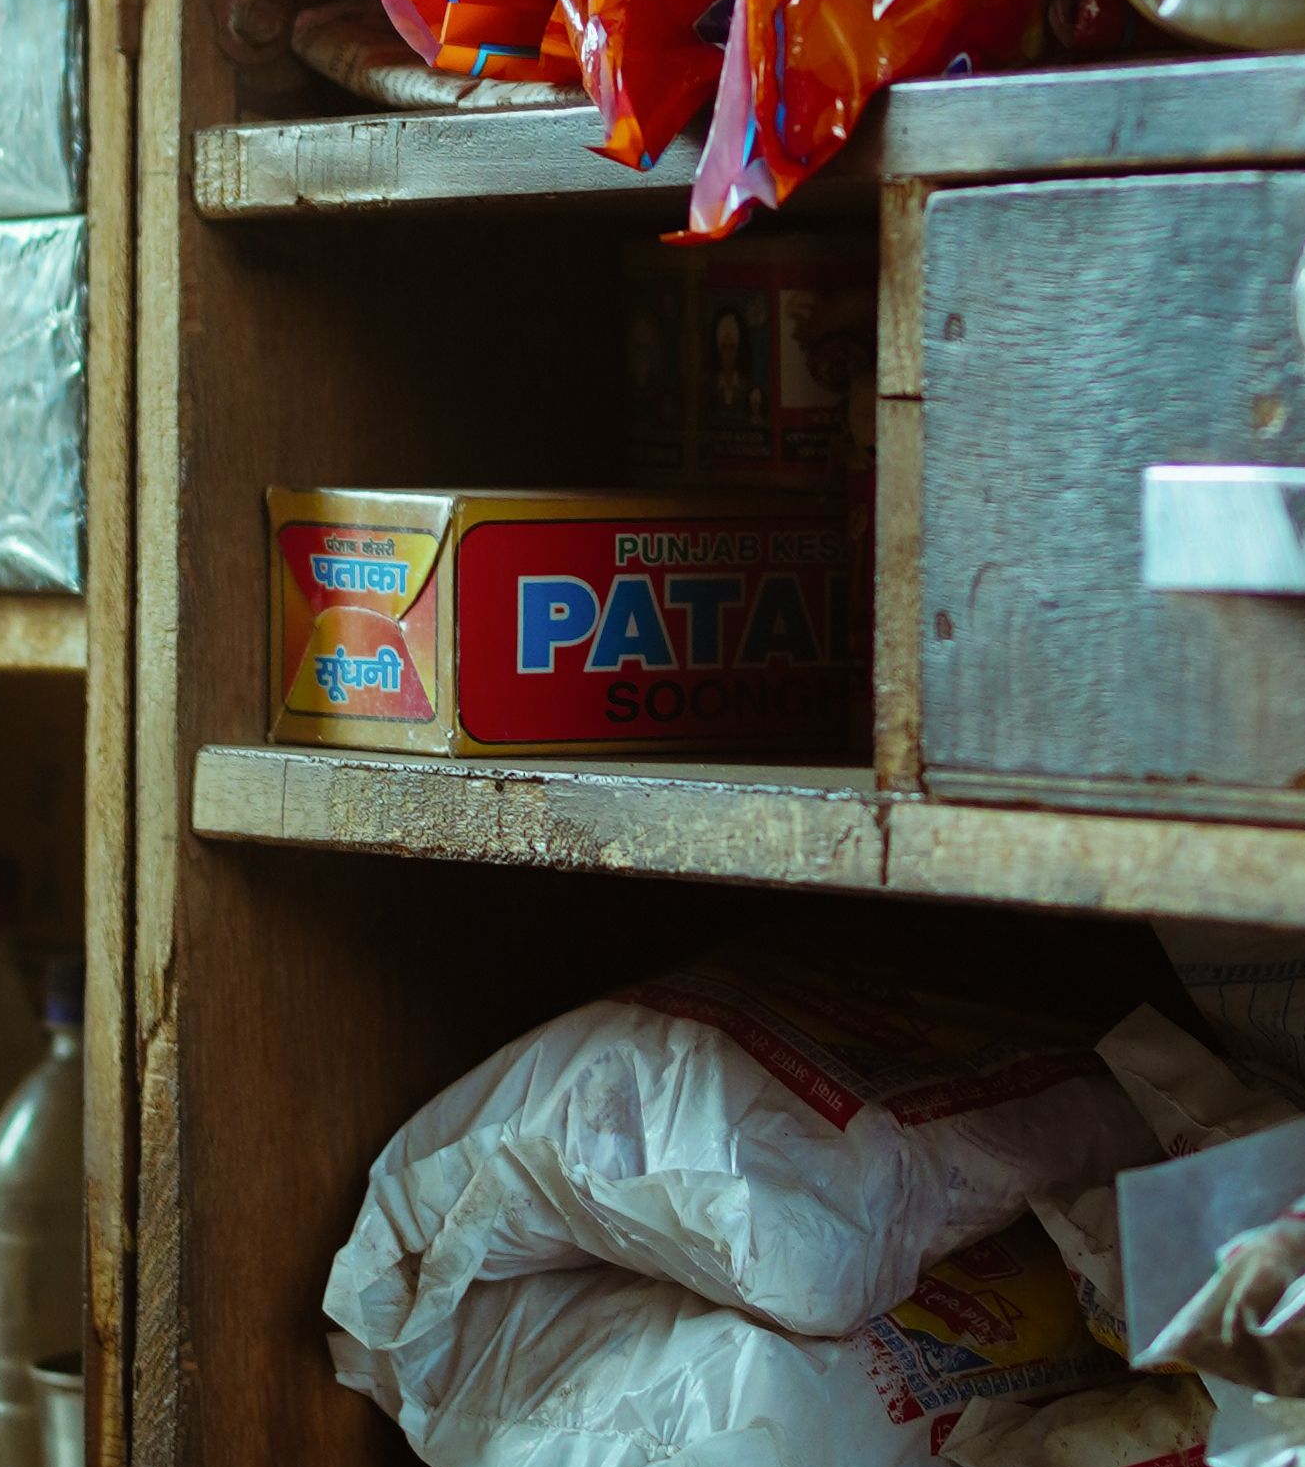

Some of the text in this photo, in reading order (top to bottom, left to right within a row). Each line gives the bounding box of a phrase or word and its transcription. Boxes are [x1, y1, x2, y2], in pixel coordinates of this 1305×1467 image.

[324, 532, 358, 554] पंजाब
[615, 531, 847, 566] PUNJAB KES
[310, 554, 410, 595] पताका
